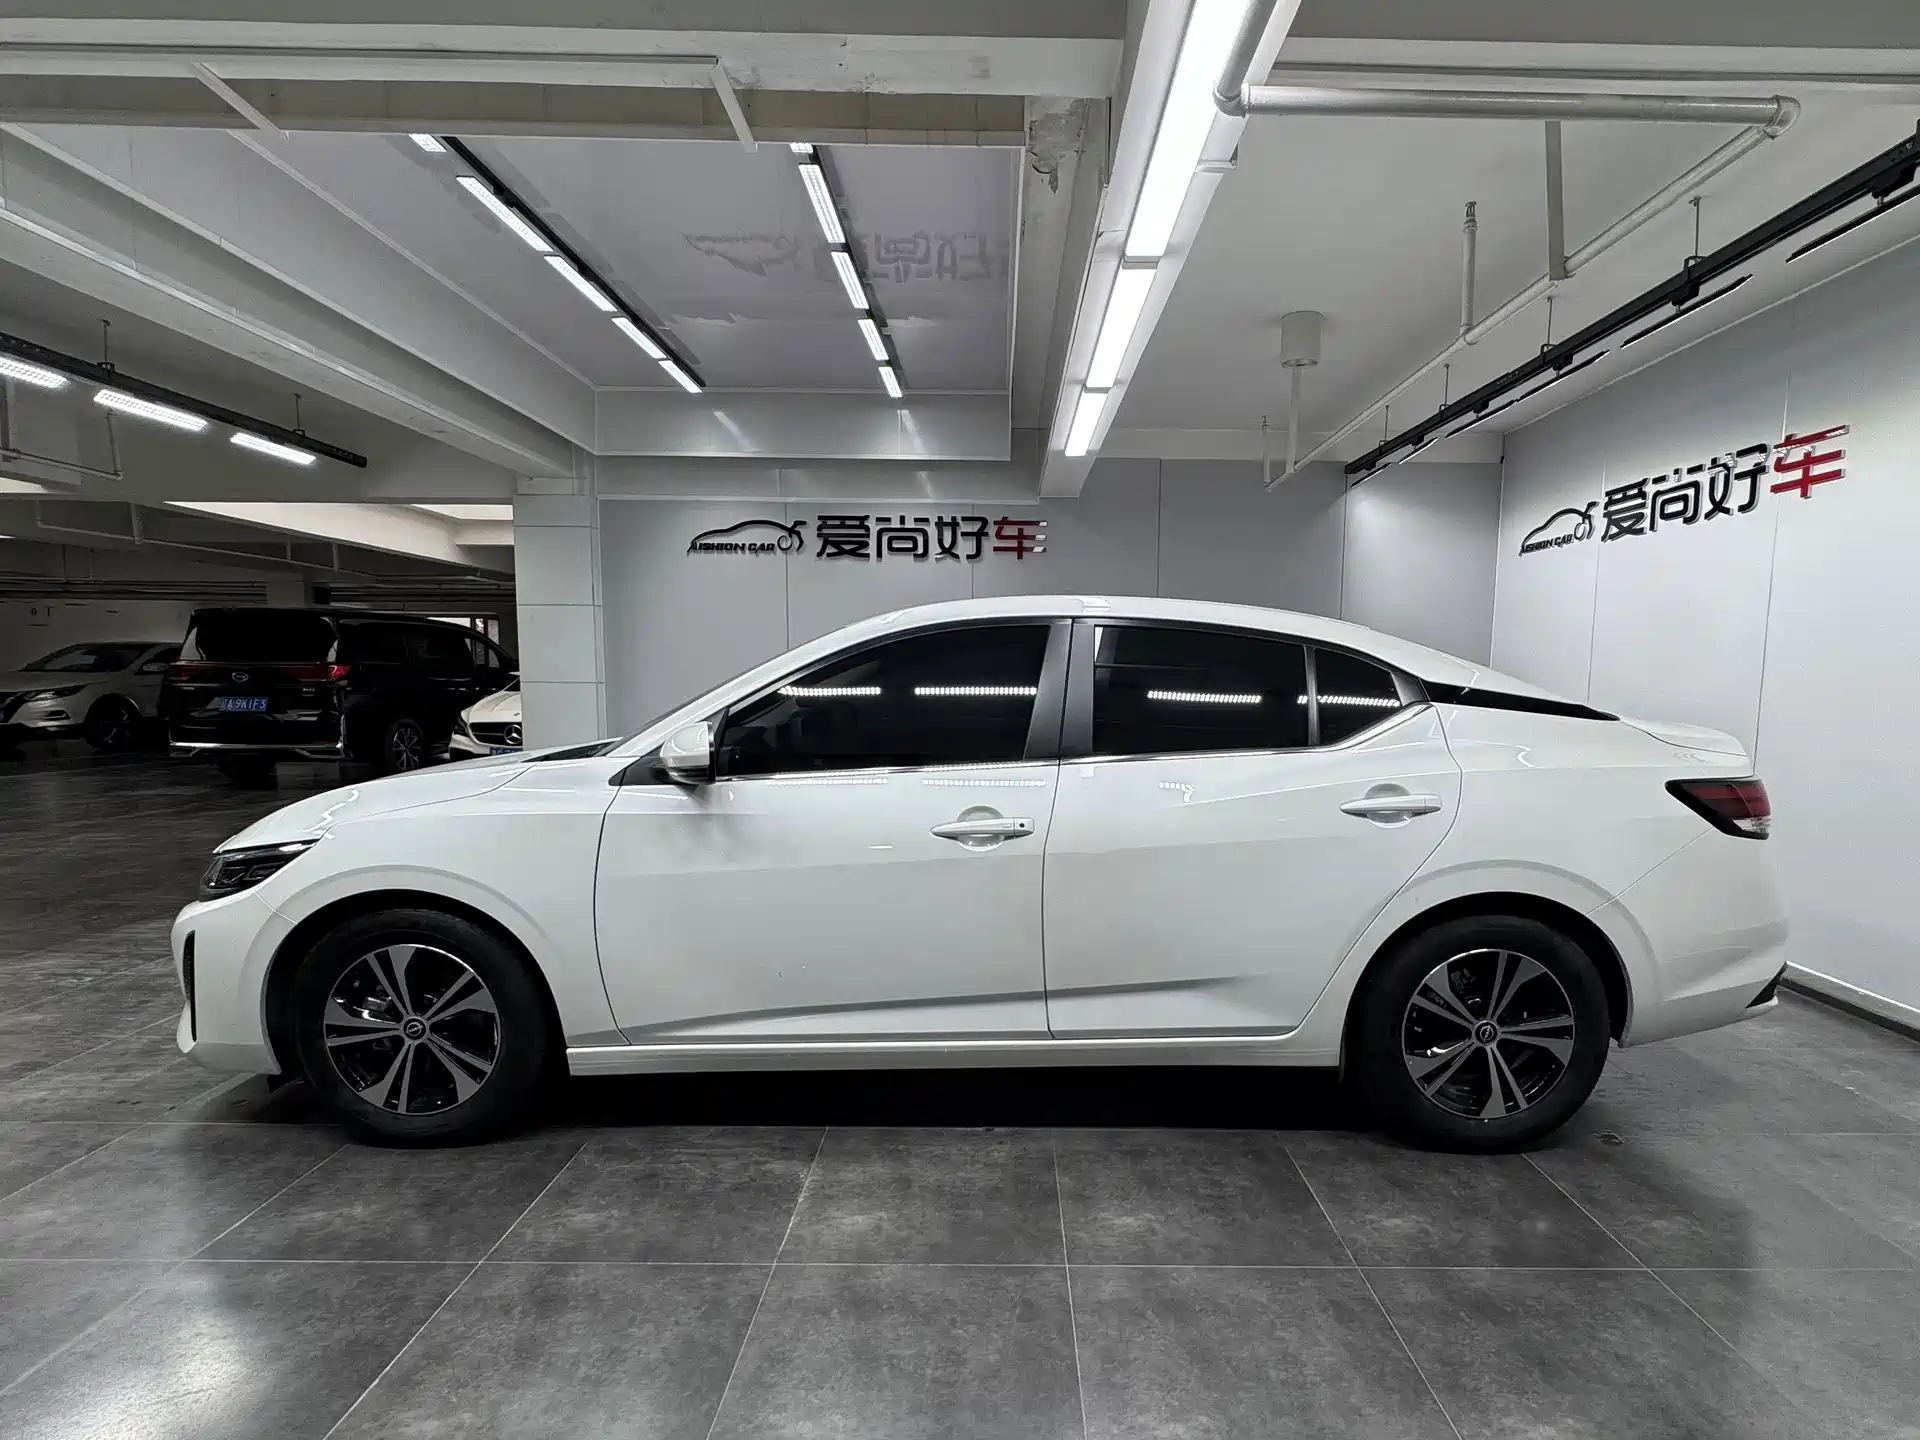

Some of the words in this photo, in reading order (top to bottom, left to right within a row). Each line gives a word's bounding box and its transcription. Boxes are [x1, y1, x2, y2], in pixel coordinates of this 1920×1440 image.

[1601, 424, 1849, 542] 爱尚好车
[748, 542, 775, 553] CAR
[817, 515, 1047, 559] 爱尚好车
